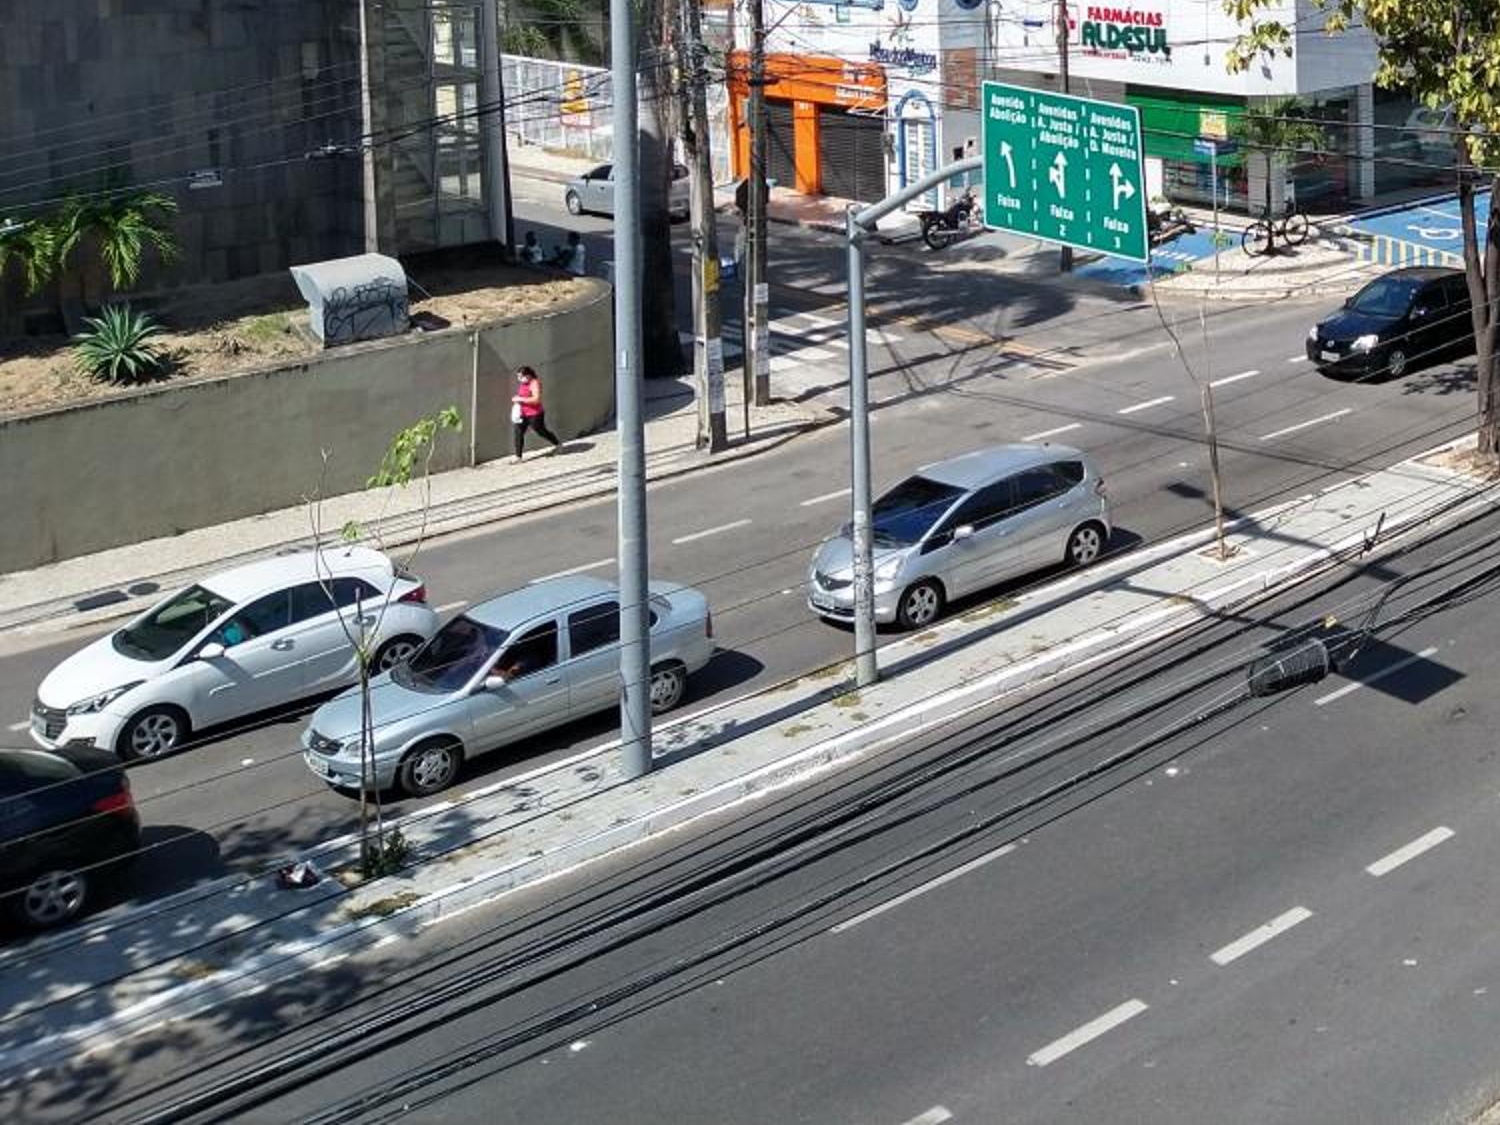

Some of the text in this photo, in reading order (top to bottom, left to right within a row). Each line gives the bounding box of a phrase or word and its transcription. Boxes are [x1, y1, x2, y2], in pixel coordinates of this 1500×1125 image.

[1087, 6, 1163, 27] FARMÁCIAS
[1082, 21, 1170, 53] ALDESUL
[989, 107, 1027, 124] Abolição
[1037, 102, 1078, 121] Avenidas
[1037, 115, 1047, 128] A.
[1090, 112, 1132, 132] Avenidas
[1039, 130, 1080, 149] Abolição
[1089, 125, 1099, 139] A.
[997, 194, 1021, 210] Faixa
[1059, 224, 1066, 236] 2
